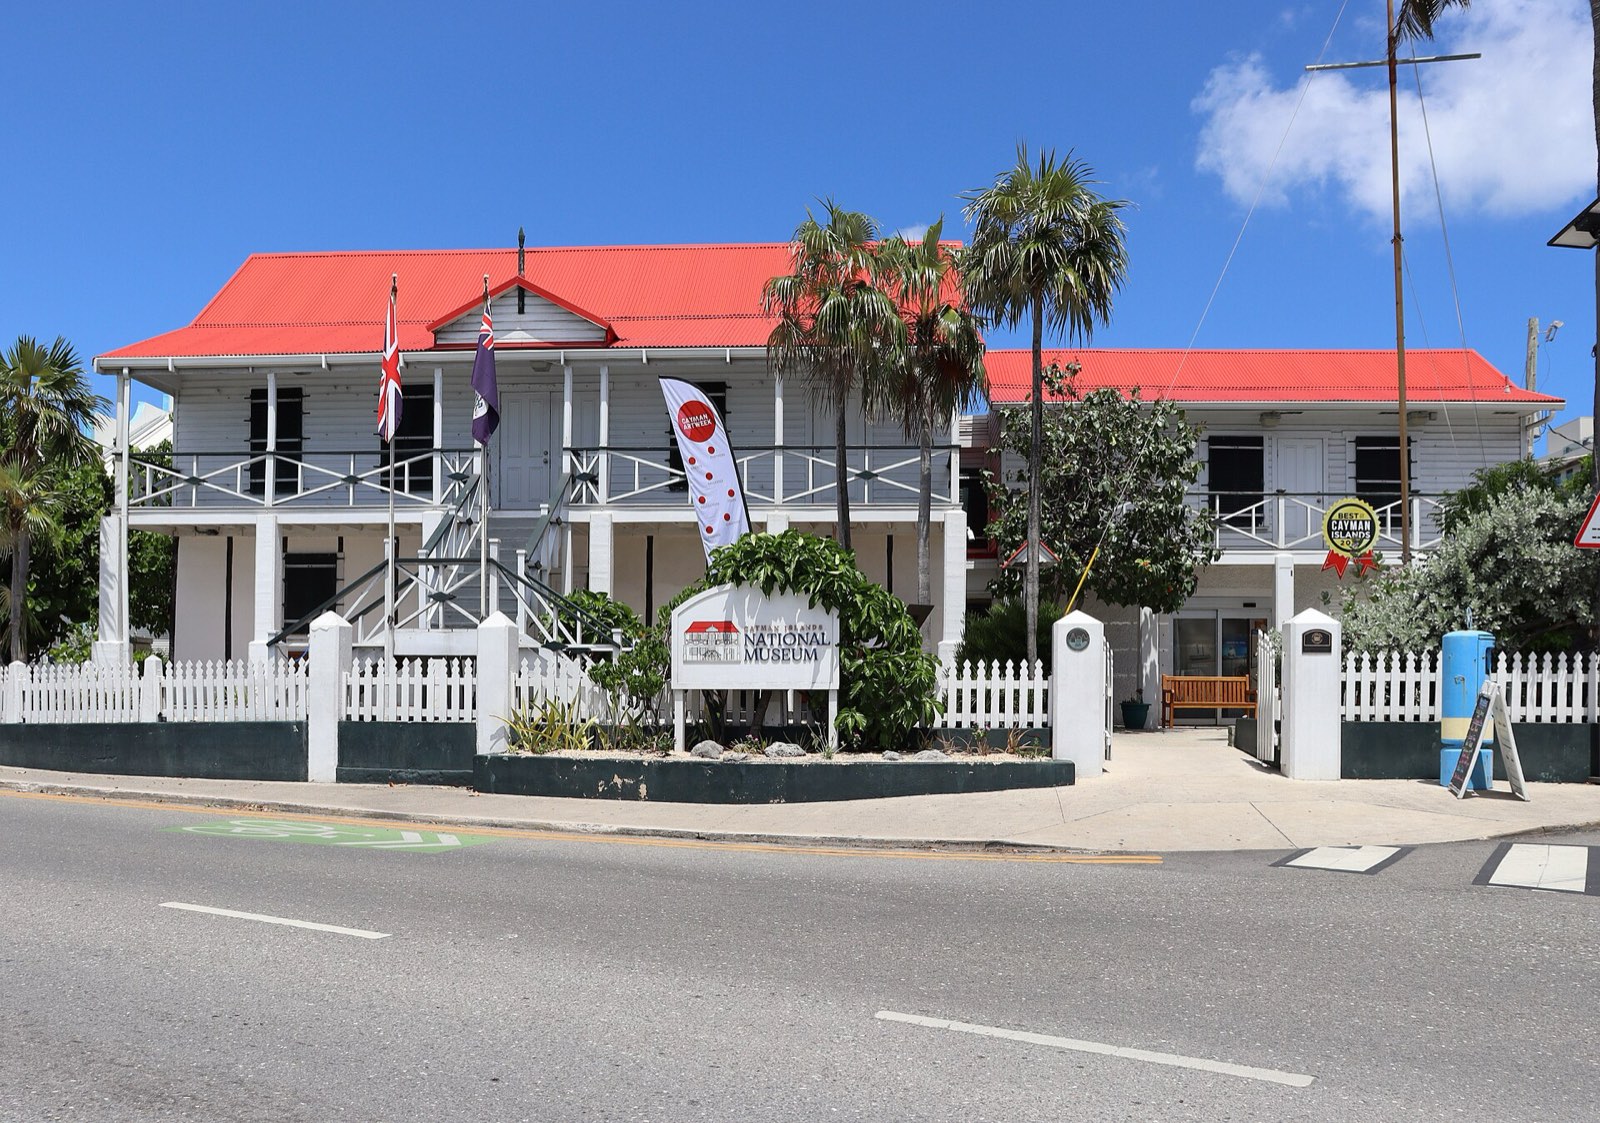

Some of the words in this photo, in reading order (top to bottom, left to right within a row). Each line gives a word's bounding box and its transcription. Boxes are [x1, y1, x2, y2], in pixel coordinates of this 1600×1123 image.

[681, 414, 708, 424] CAYMAN
[1331, 520, 1371, 531] CAYMAN
[744, 625, 779, 633] CAYMAN
[744, 632, 831, 646] NATIONAL
[744, 648, 818, 661] MUSEUM
